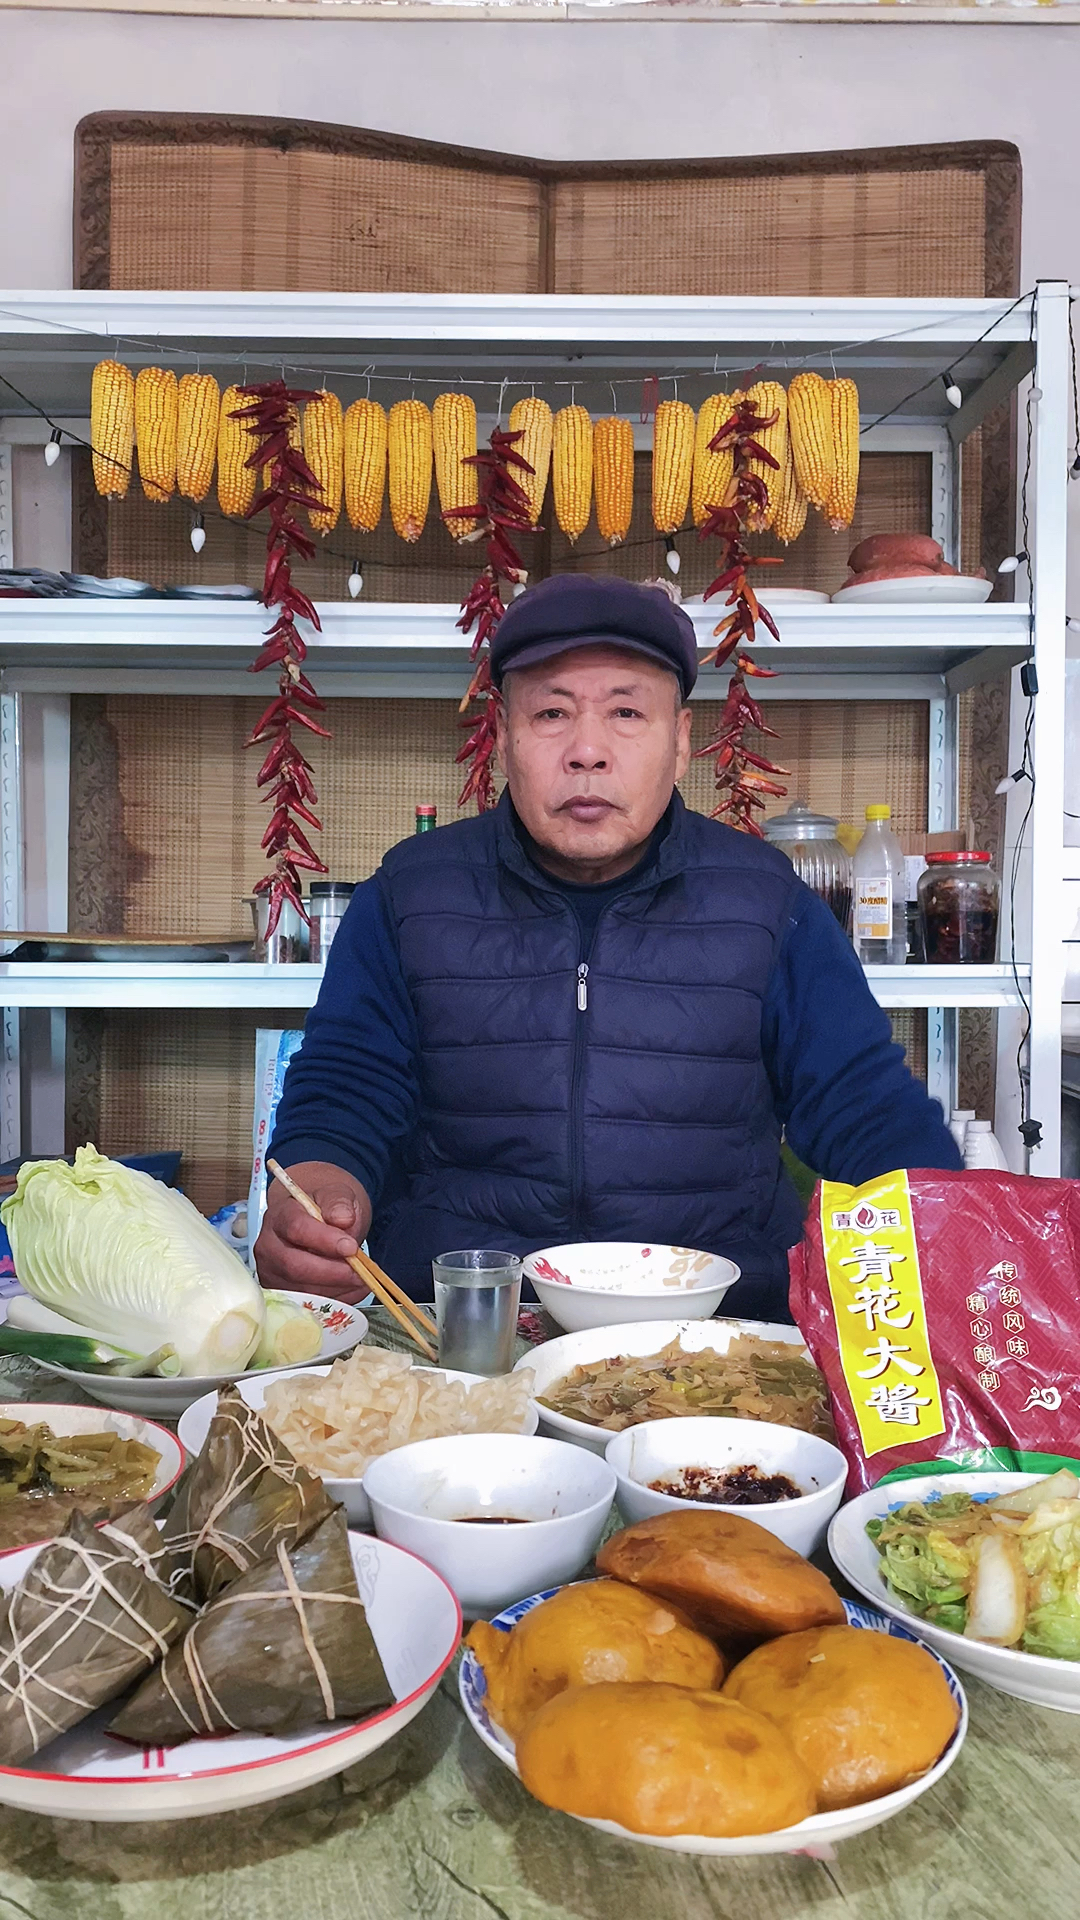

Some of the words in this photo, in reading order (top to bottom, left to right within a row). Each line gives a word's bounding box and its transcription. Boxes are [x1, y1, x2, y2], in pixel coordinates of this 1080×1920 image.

[838, 1240, 932, 1426] 青花大酱
[968, 1294, 998, 1389] 精心酿制
[1000, 1262, 1027, 1356] 传统风味
